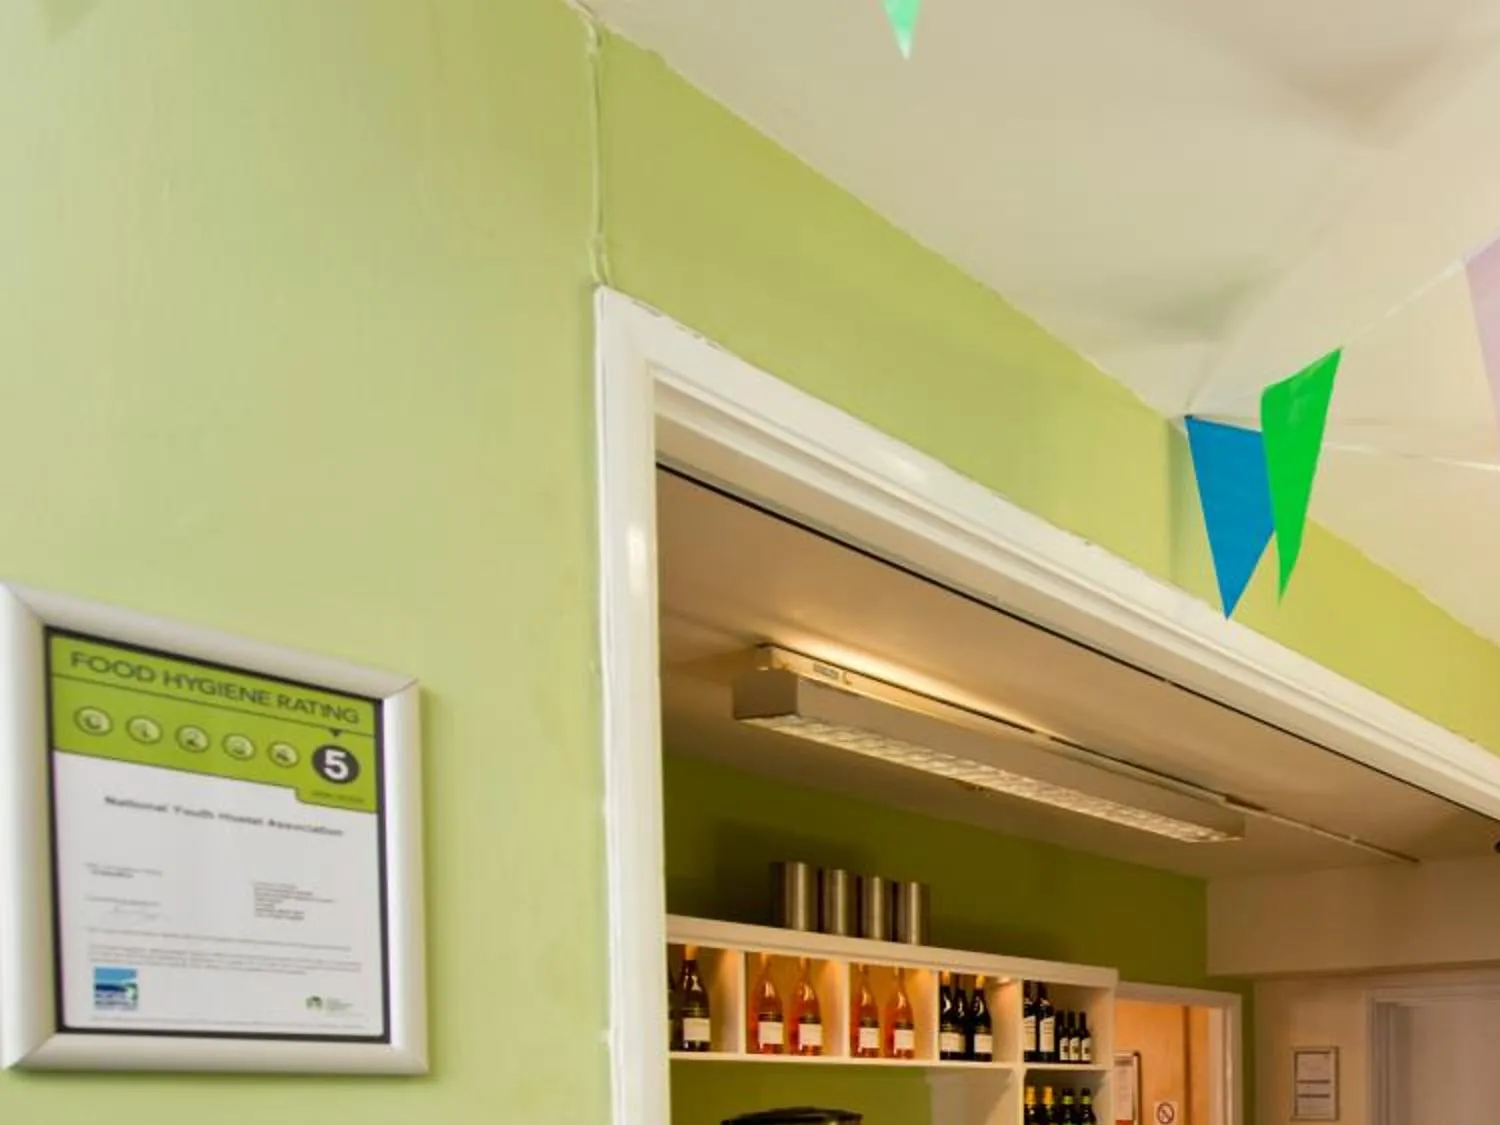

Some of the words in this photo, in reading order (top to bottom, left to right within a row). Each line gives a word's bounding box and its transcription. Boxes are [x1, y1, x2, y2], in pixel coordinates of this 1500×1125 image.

[70, 651, 157, 683] FOOD
[163, 670, 273, 708] HYGIENE
[277, 694, 360, 725] RATING
[324, 748, 350, 781] 5
